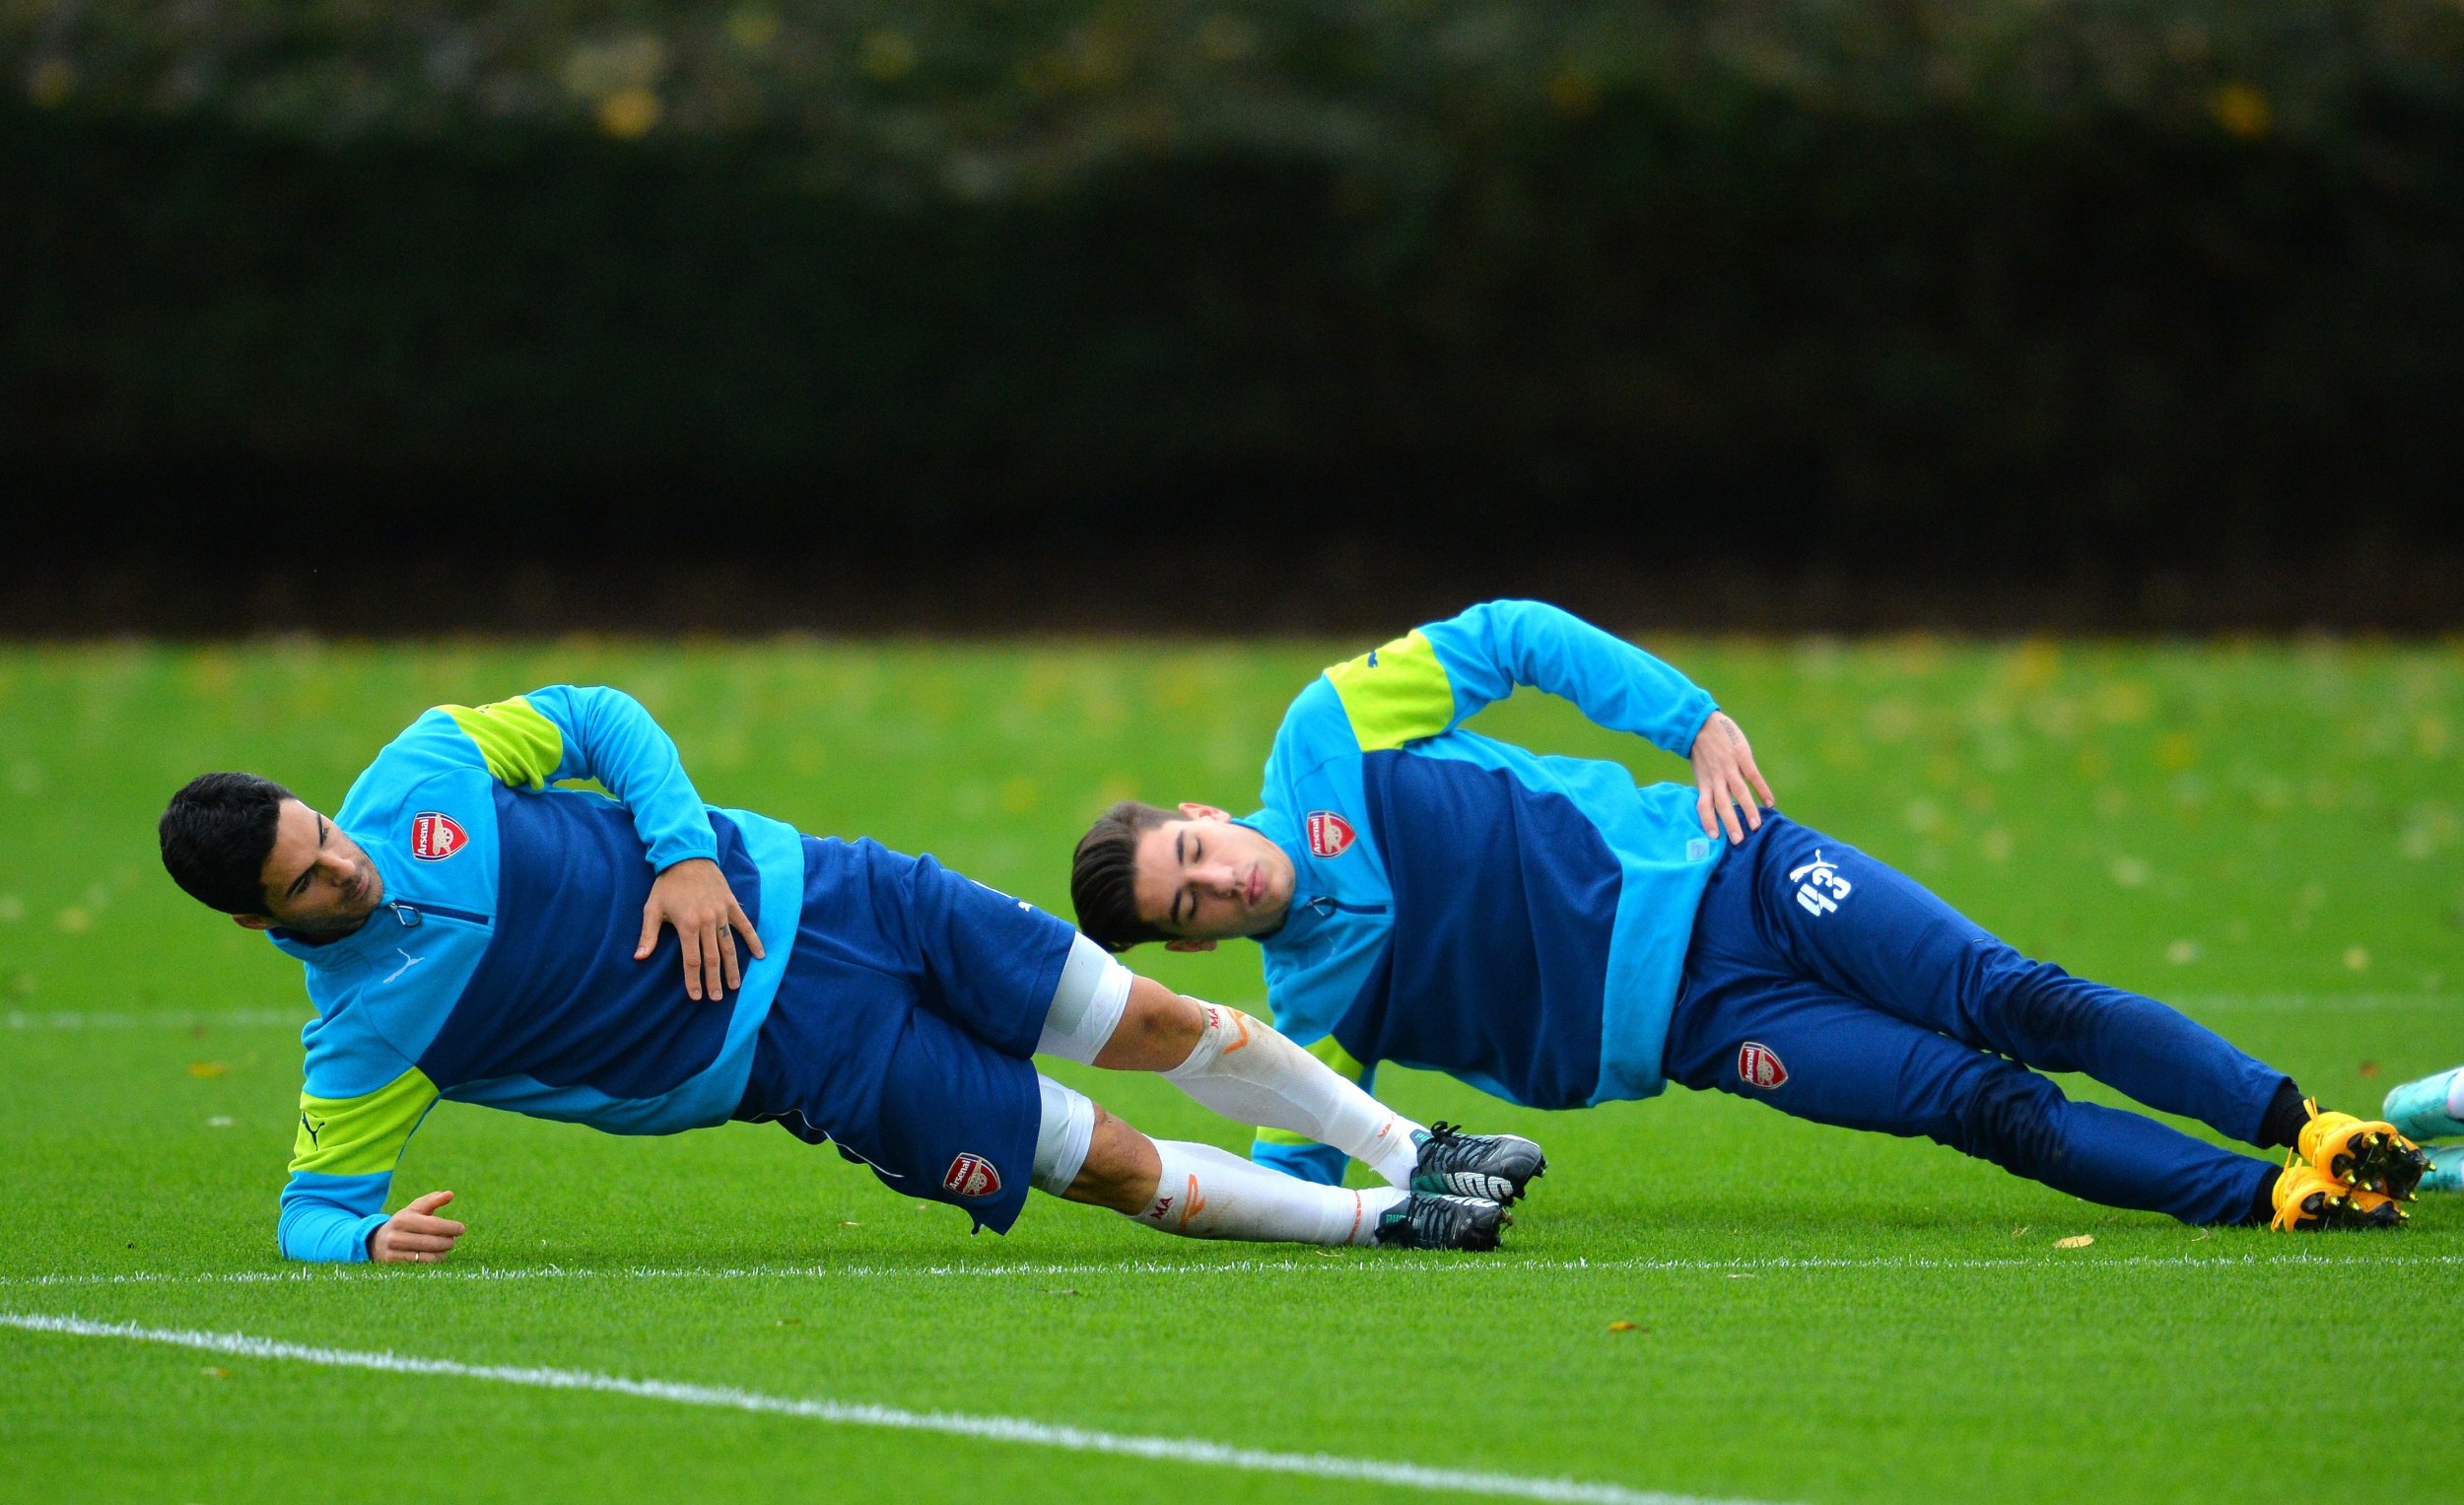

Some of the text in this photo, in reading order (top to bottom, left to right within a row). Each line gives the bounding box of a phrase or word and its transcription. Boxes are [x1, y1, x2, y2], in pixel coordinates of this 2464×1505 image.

[417, 818, 430, 855] Arsenal
[1311, 818, 1322, 854] Arsenal
[1796, 867, 1851, 918] 43
[1207, 1007, 1219, 1030] MA
[1745, 1049, 1754, 1082] Arsenal
[949, 1159, 971, 1191] Arsenal
[1149, 1196, 1173, 1220] MA
